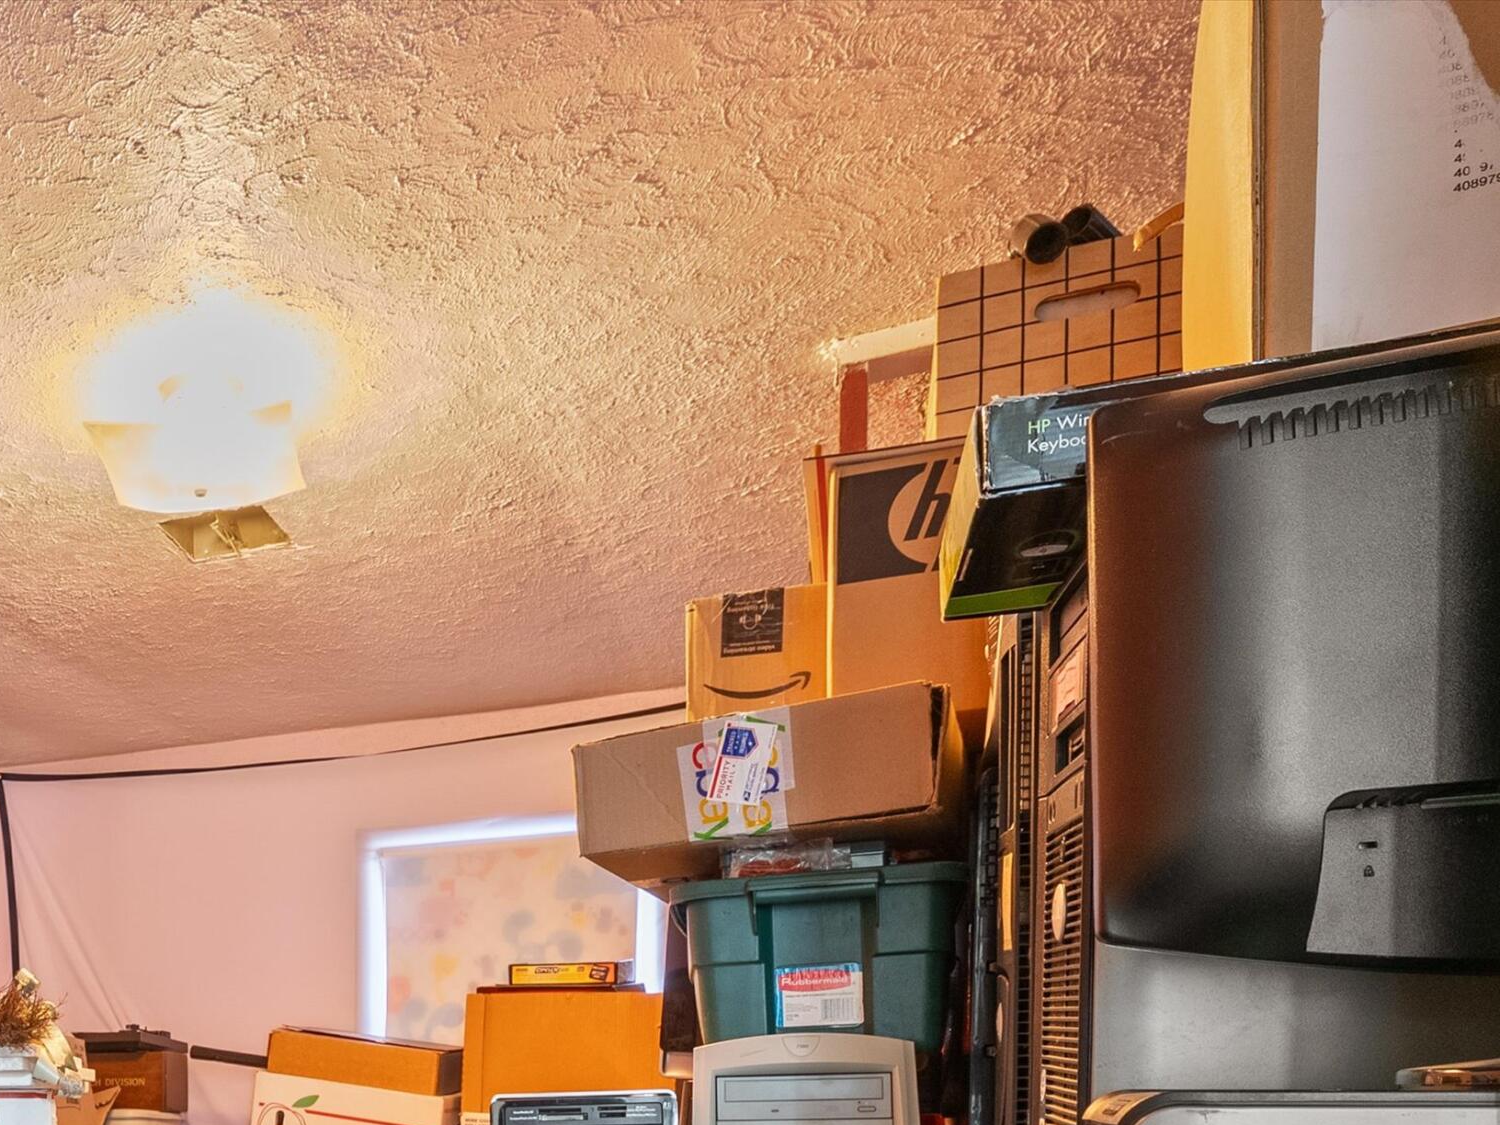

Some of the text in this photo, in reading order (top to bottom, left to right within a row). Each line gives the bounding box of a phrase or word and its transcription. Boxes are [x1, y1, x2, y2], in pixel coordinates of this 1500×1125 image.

[1028, 418, 1051, 435] HP
[716, 760, 731, 798] PRIORITY
[726, 771, 736, 791] MAIL
[104, 1078, 146, 1087] DIVISION
